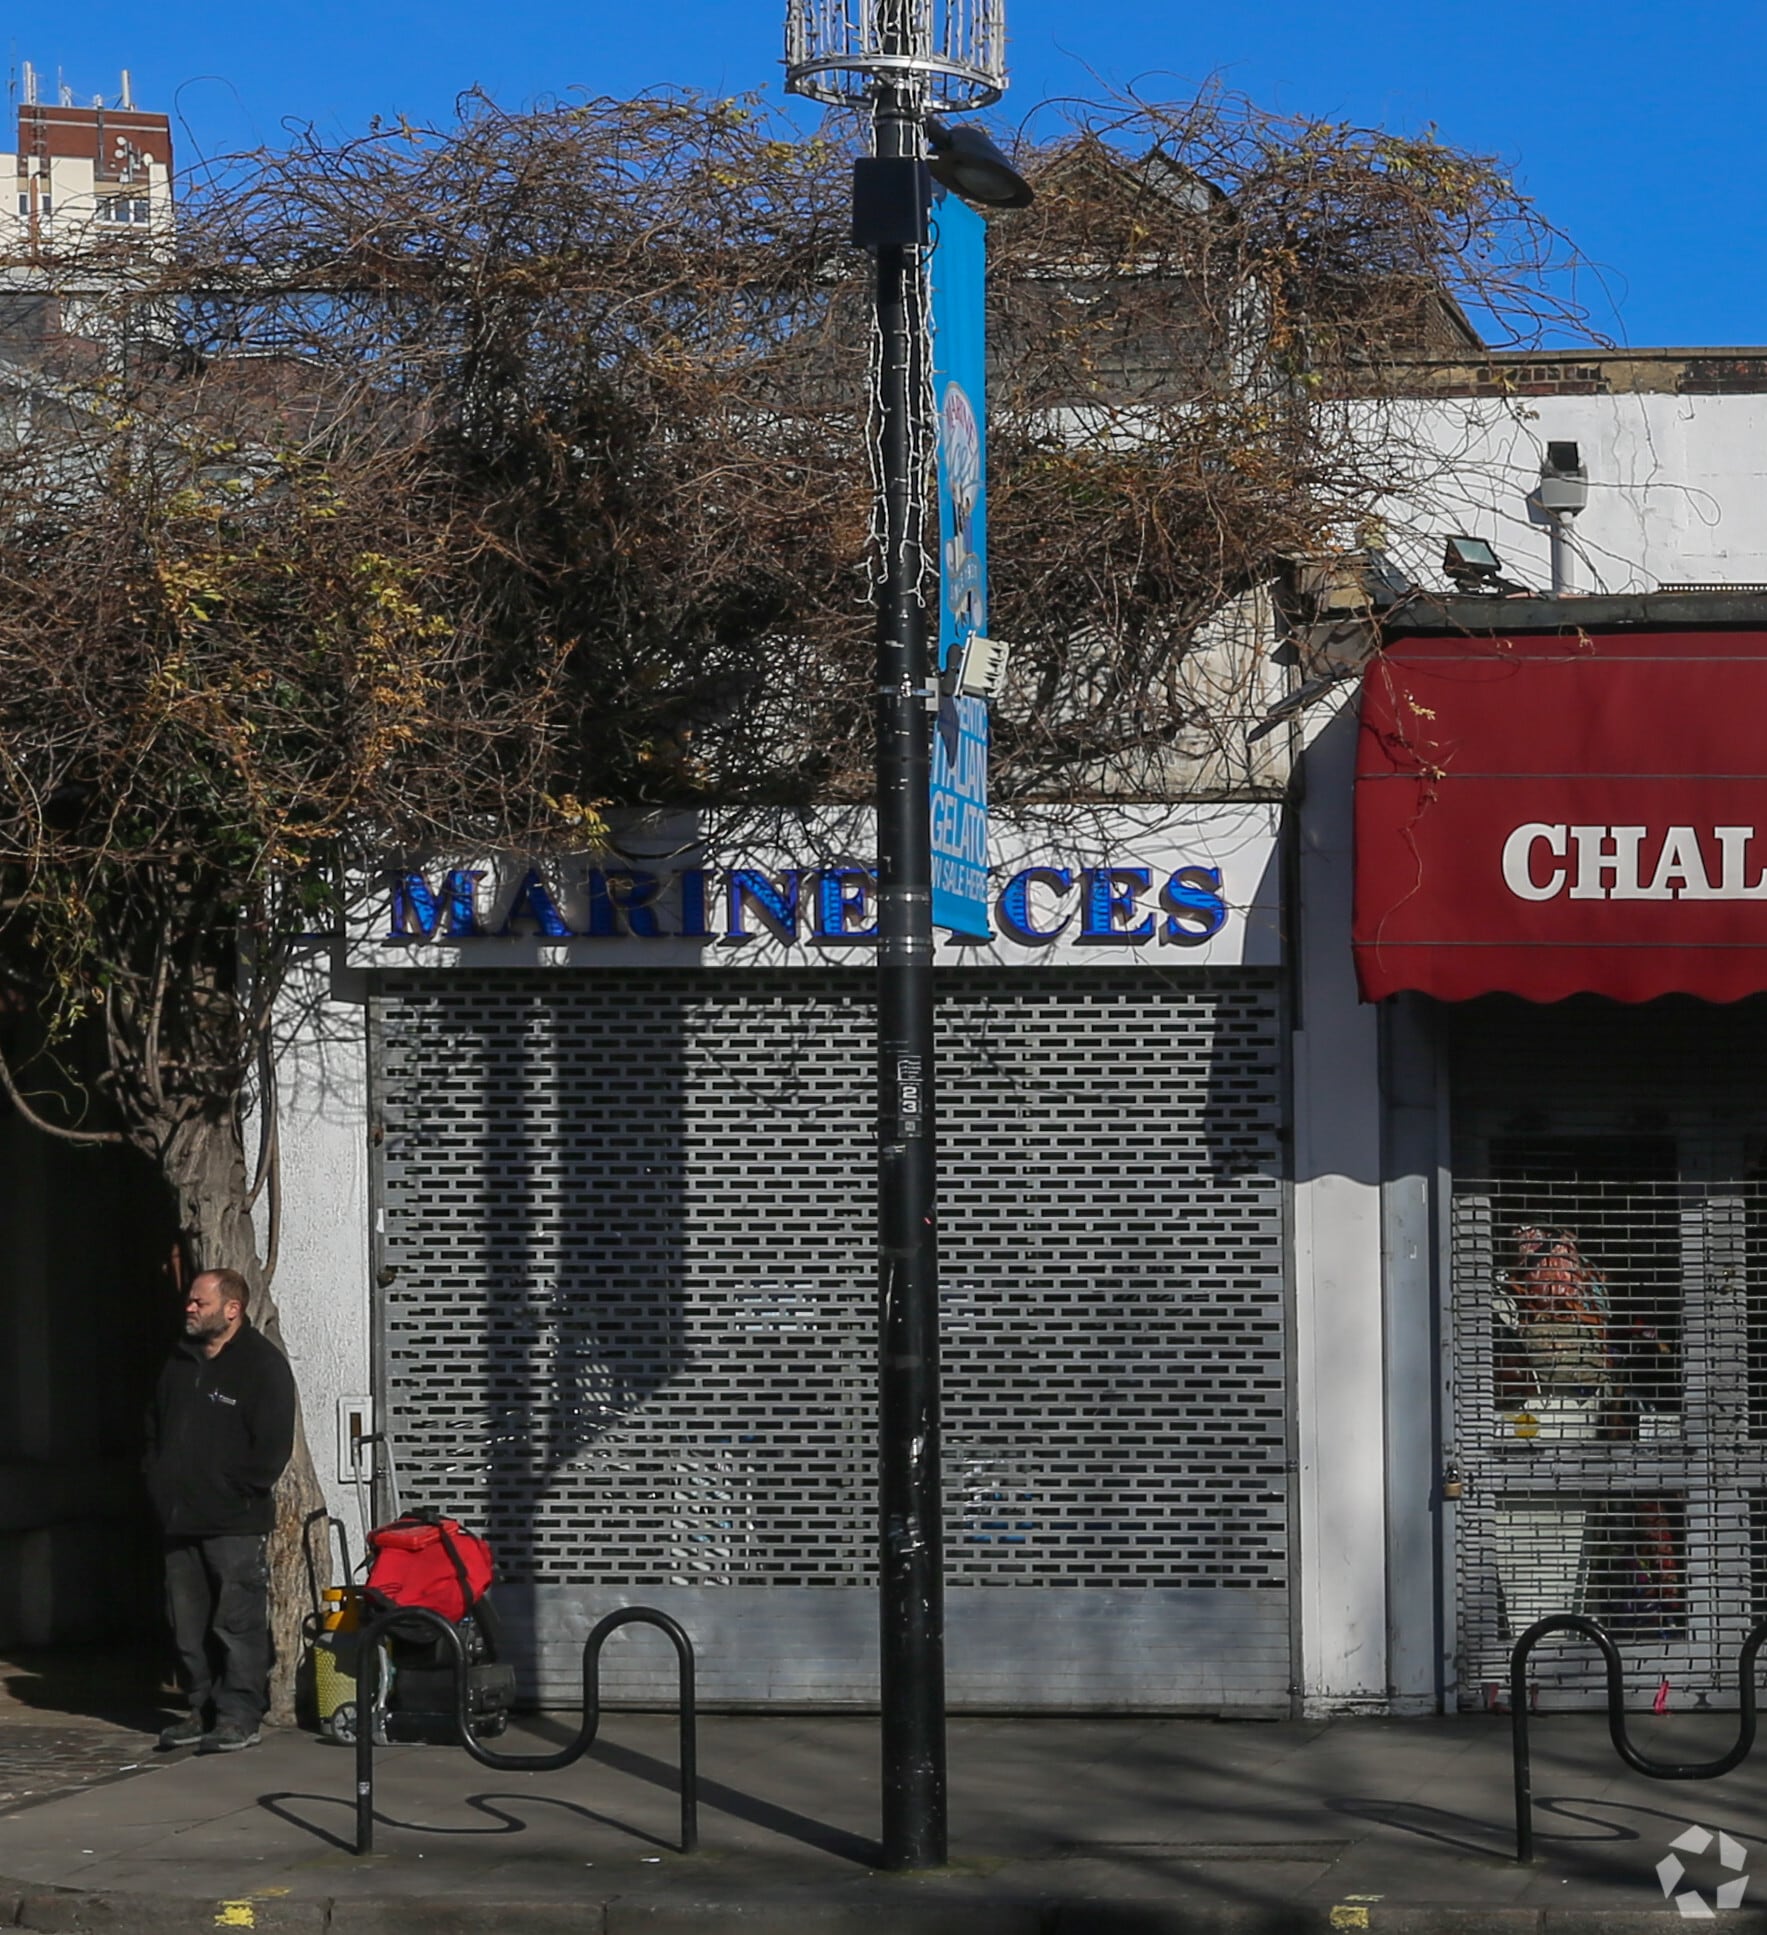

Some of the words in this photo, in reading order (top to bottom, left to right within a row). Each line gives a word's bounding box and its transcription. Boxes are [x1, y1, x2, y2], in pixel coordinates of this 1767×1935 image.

[931, 791, 987, 867] GELATO
[1502, 823, 1766, 901] CHAL
[384, 866, 878, 946] MARINE
[945, 866, 1228, 947] CES
[943, 860, 965, 896] SALE
